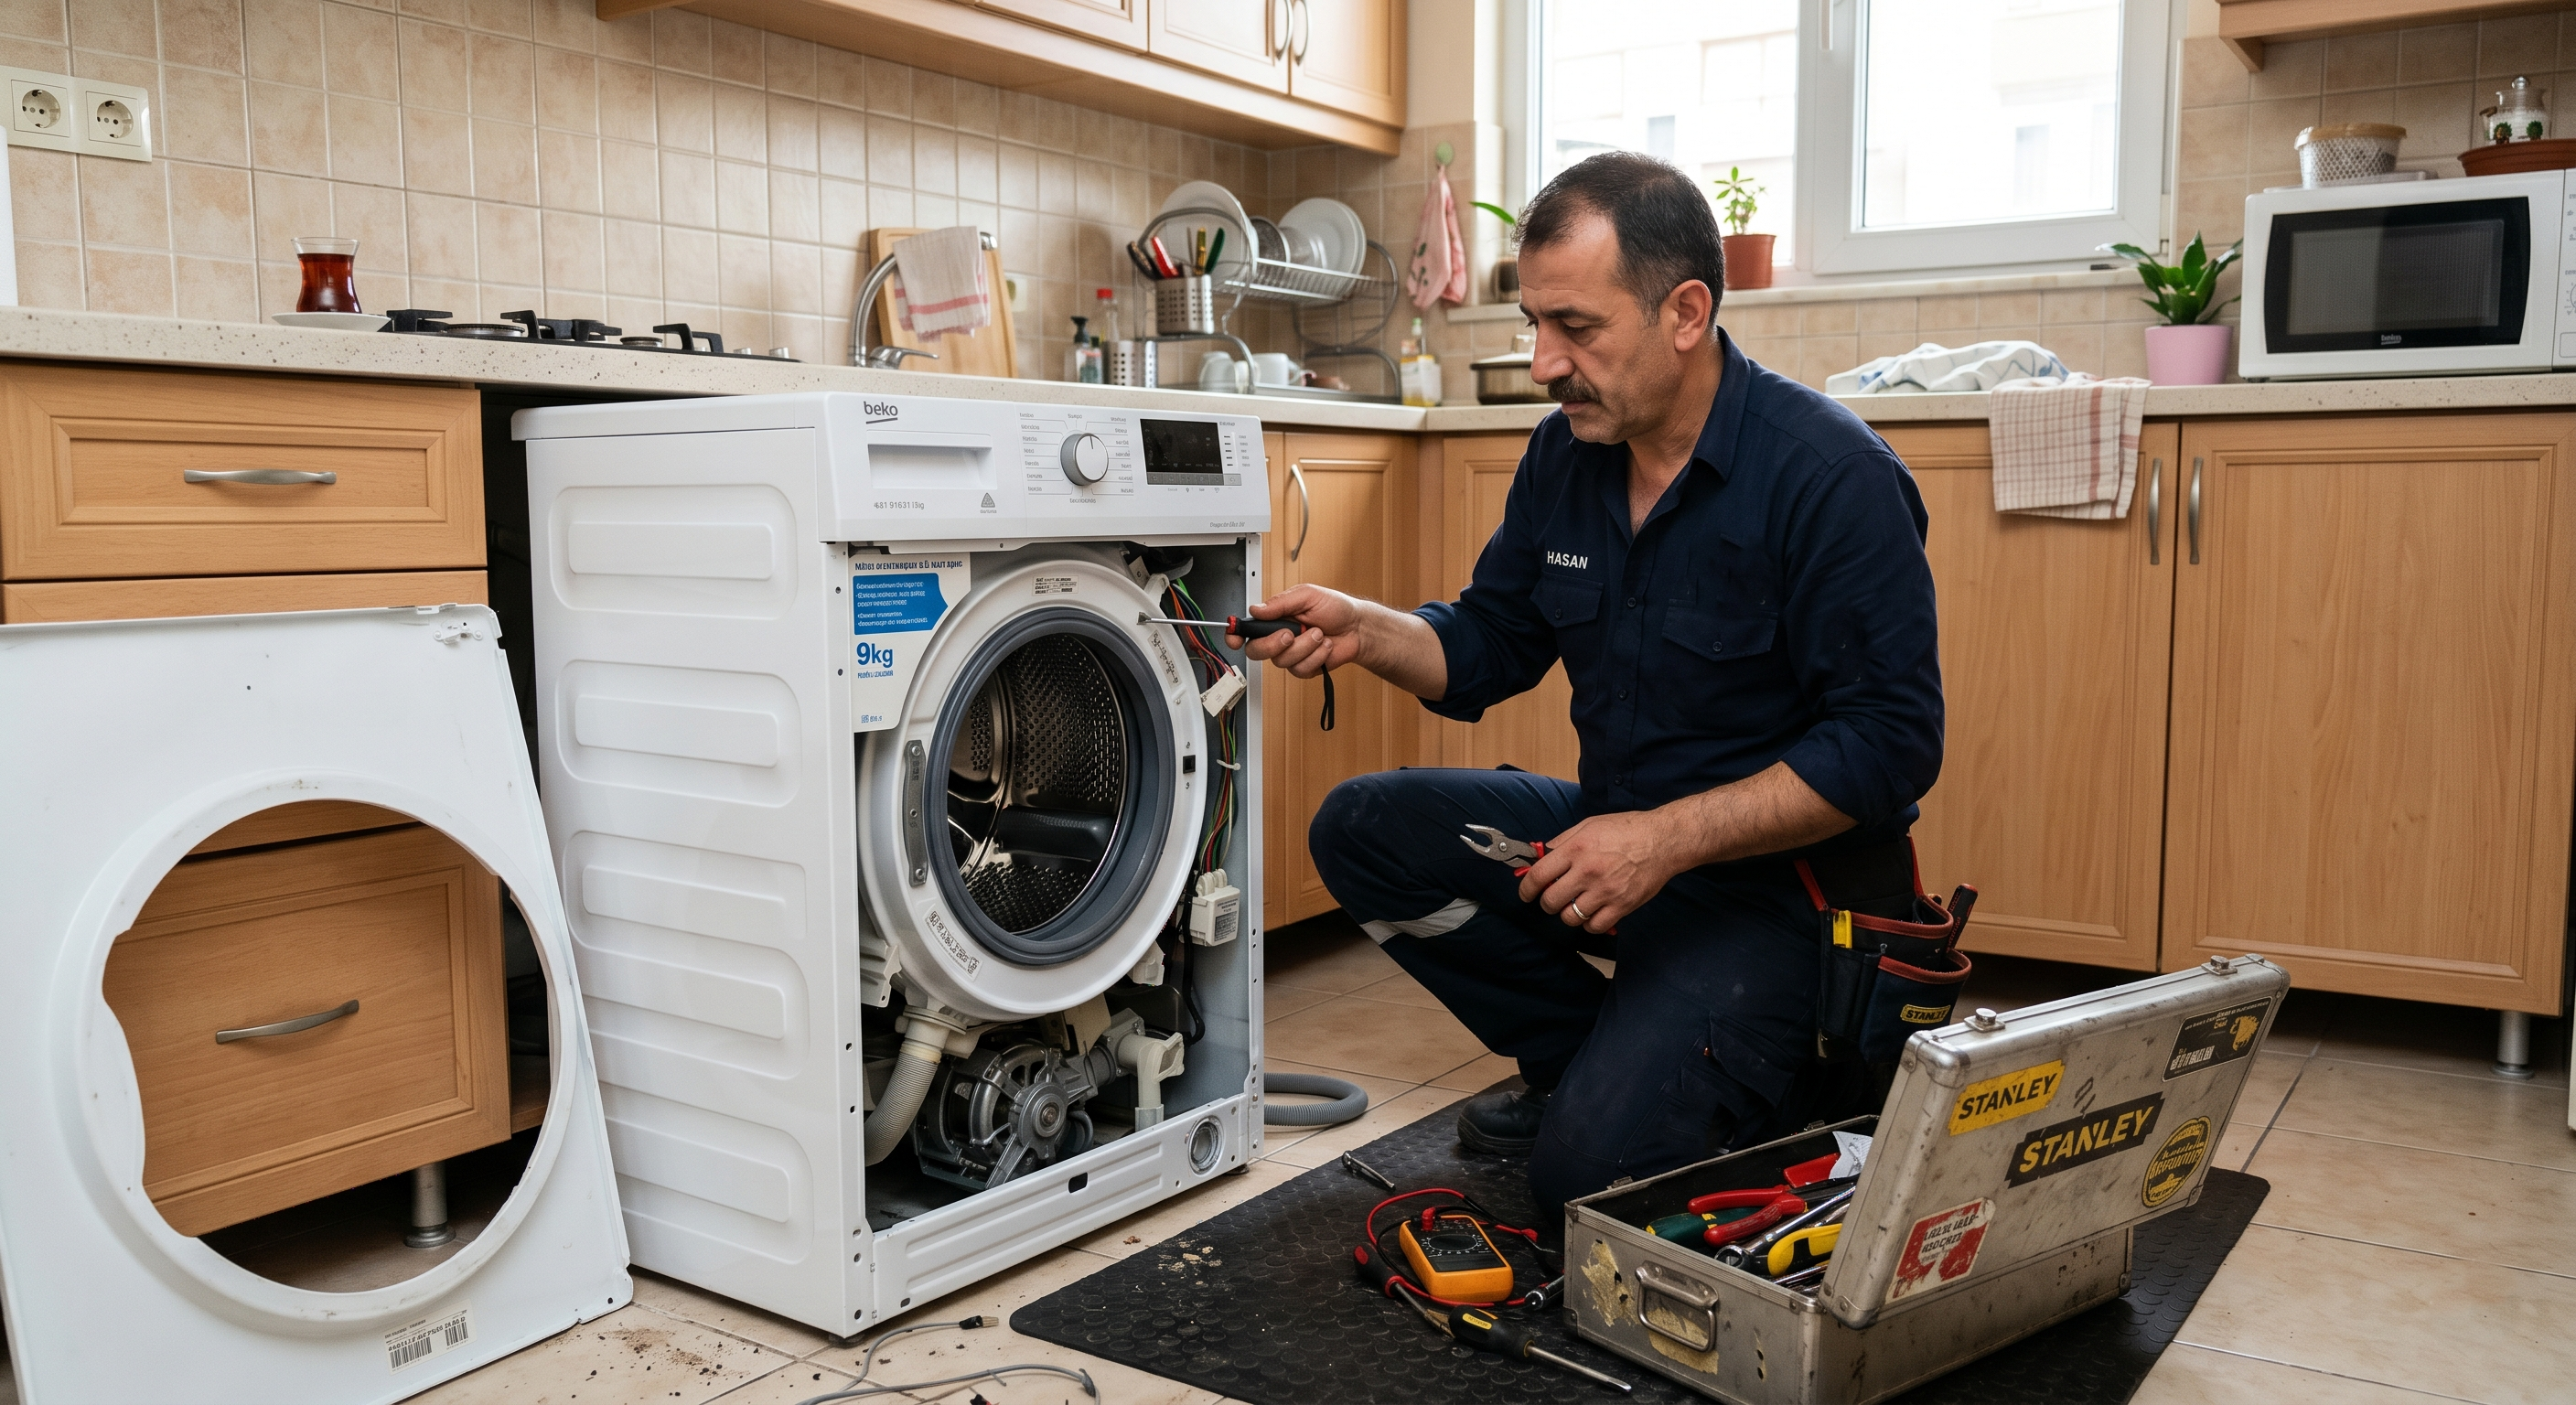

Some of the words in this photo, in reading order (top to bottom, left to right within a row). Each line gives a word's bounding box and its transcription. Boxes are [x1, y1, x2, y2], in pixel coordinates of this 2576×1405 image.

[864, 401, 898, 416] beko
[1547, 551, 1588, 570] HASAN
[856, 642, 894, 669] 9kg
[1959, 1073, 2057, 1121] STANLEY
[2019, 1106, 2154, 1174] STANLEY
